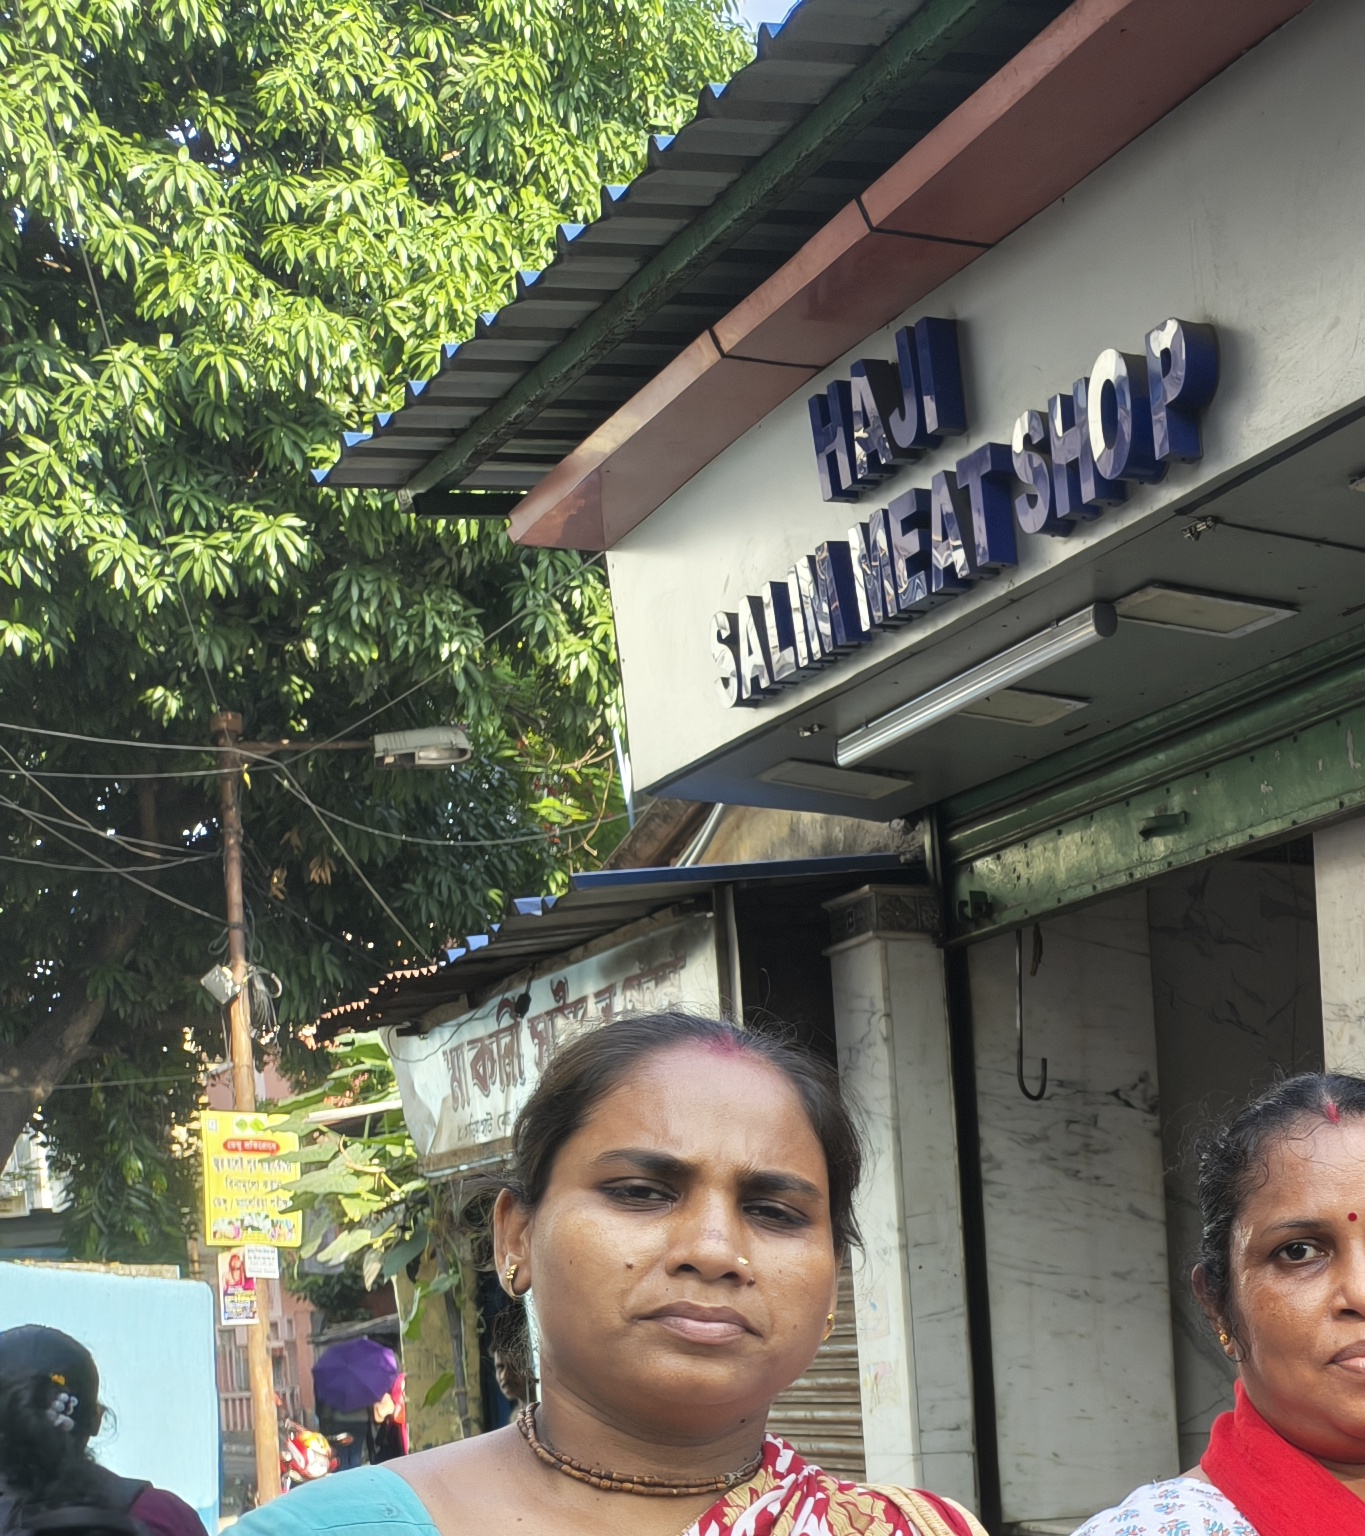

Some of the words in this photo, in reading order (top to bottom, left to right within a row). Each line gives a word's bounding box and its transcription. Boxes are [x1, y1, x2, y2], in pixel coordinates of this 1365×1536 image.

[708, 540, 872, 711] SALIM
[847, 442, 1019, 635] MEAT
[1011, 316, 1220, 539] SHOP
[807, 316, 968, 503] HAJI
